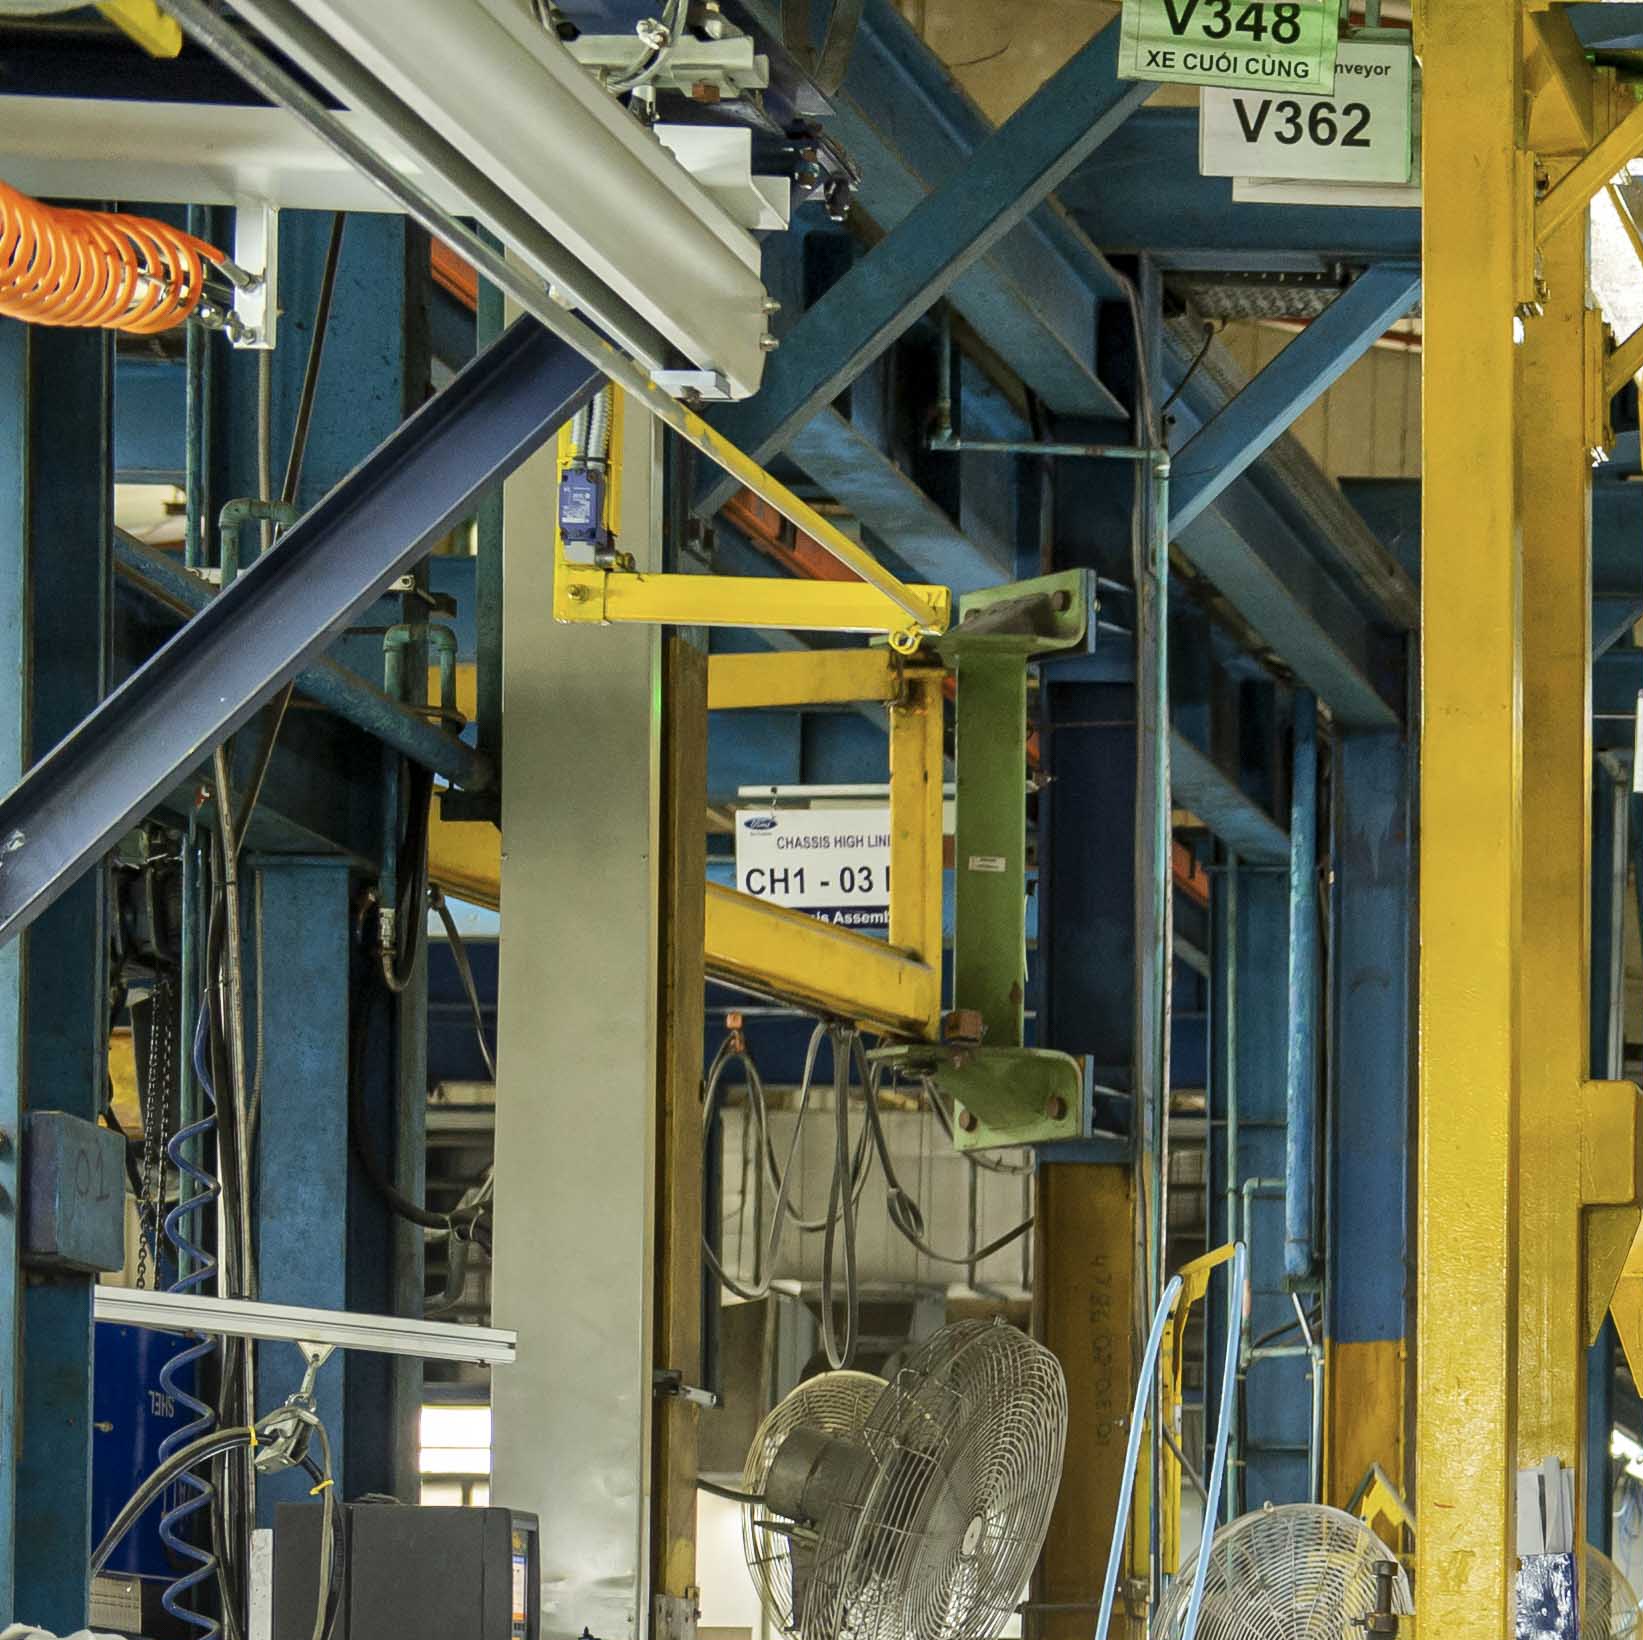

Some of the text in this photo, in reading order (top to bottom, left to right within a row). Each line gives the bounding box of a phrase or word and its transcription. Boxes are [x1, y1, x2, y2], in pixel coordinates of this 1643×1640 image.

[1162, 0, 1301, 44] V348
[1146, 50, 1176, 69] XE
[1245, 54, 1311, 79] CÙNG
[1232, 98, 1372, 148] V362
[777, 835, 890, 850] CHASSIS HIGH LIN
[745, 867, 805, 896] CH1
[839, 866, 874, 893] 03
